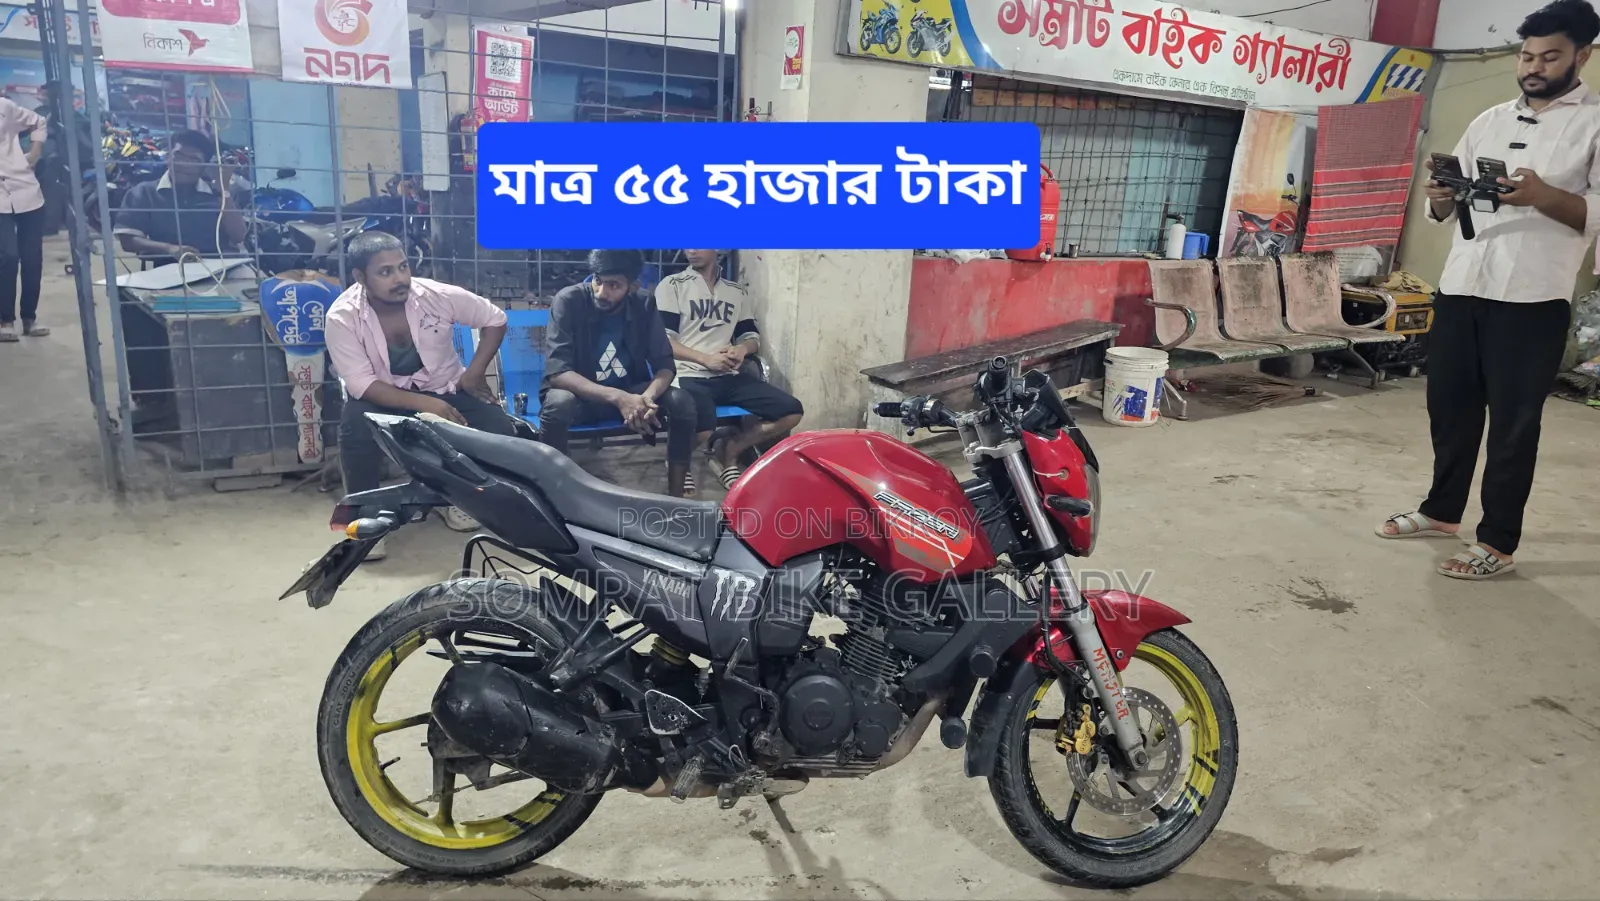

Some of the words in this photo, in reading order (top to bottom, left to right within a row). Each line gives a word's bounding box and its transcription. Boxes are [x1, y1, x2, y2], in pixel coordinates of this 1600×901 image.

[143, 32, 183, 51] বিকাশ
[1122, 8, 1227, 70] বাইক
[1233, 33, 1352, 94] গ্যালারী
[303, 47, 391, 84] নগদ
[1145, 72, 1167, 87] বাইক
[689, 298, 736, 325] NIKE
[642, 568, 691, 599] YAMAHA
